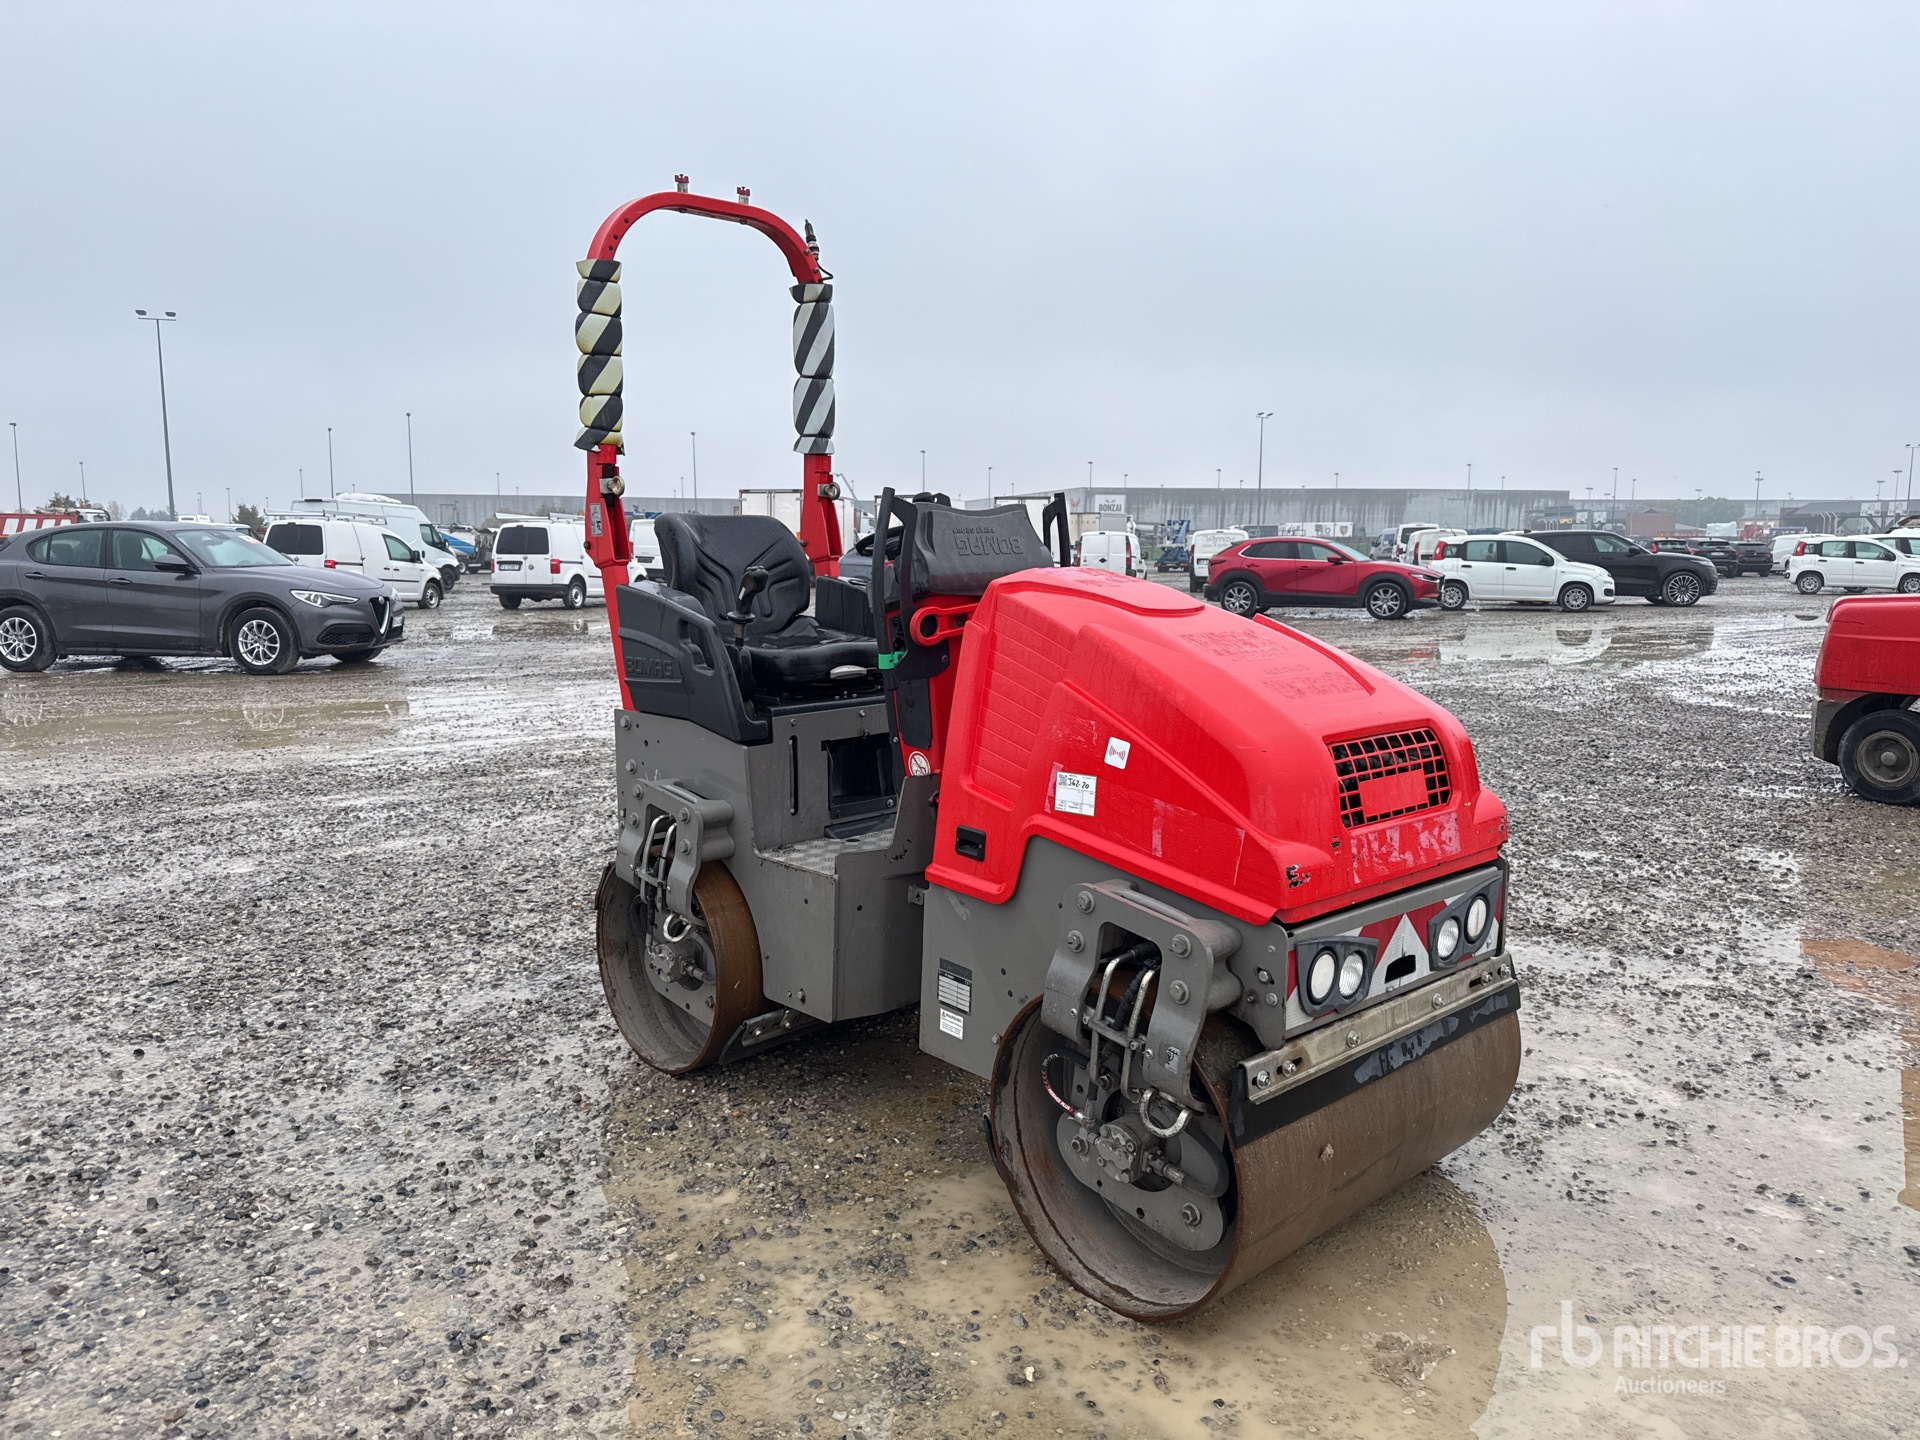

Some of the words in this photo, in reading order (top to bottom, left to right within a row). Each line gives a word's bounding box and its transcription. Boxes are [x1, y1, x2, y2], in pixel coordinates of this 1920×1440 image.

[1098, 503, 1122, 512] BONZAI
[954, 535, 1024, 556] BOMAG
[625, 655, 673, 677] BOMAG
